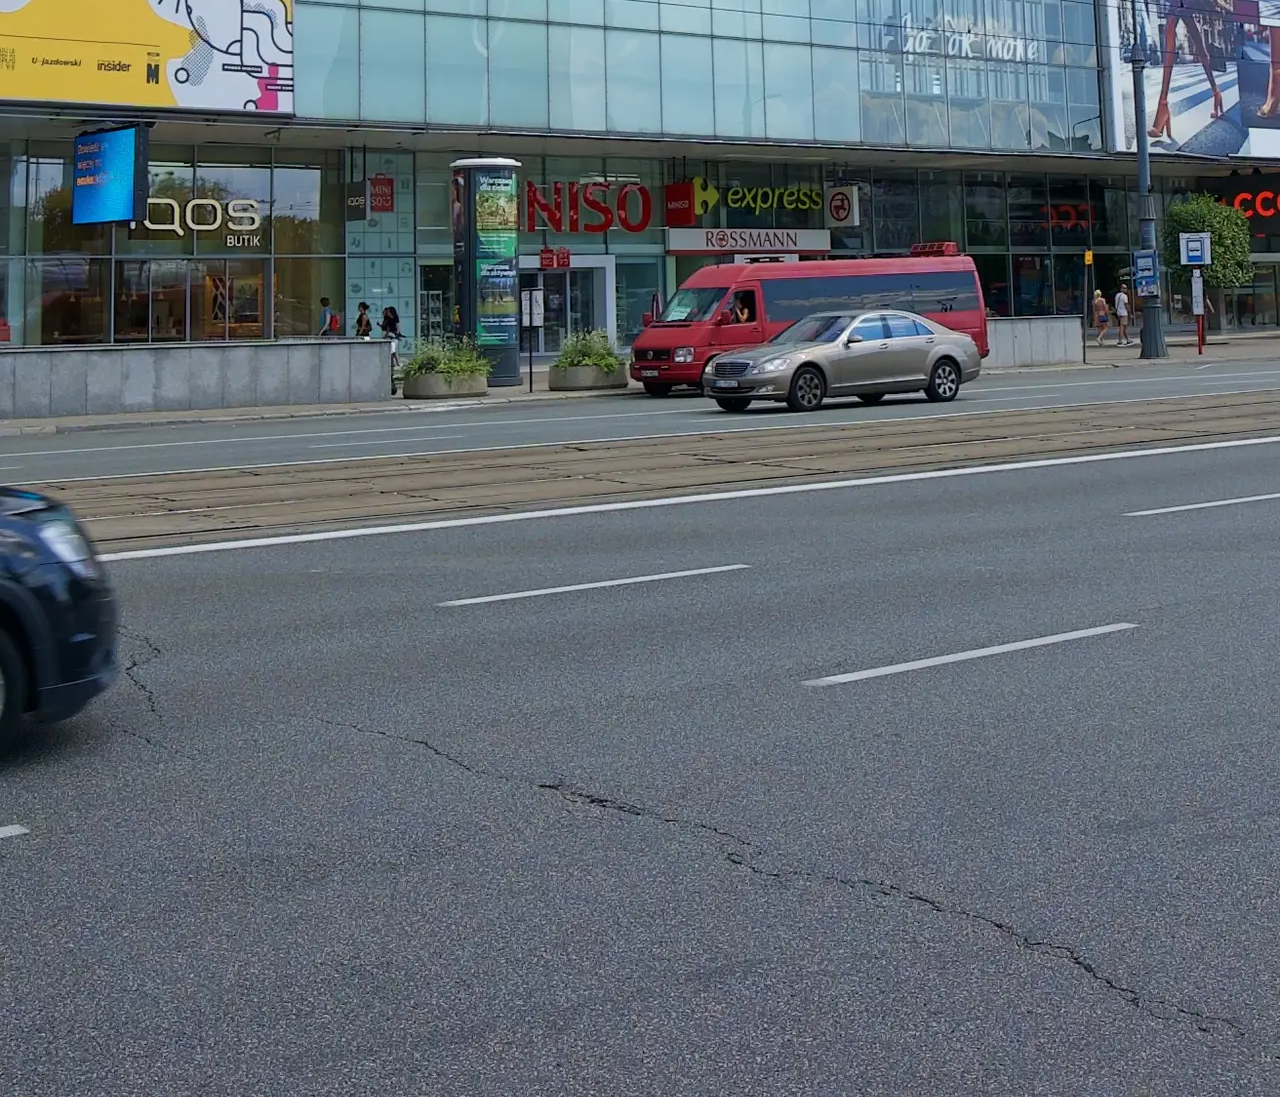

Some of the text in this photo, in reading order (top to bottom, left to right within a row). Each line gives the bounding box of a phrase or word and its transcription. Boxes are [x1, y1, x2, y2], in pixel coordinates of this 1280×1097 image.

[727, 186, 823, 216] express
[130, 197, 262, 237] QOS
[227, 235, 261, 247] BUTIK
[705, 230, 798, 249] ROSSMANN
